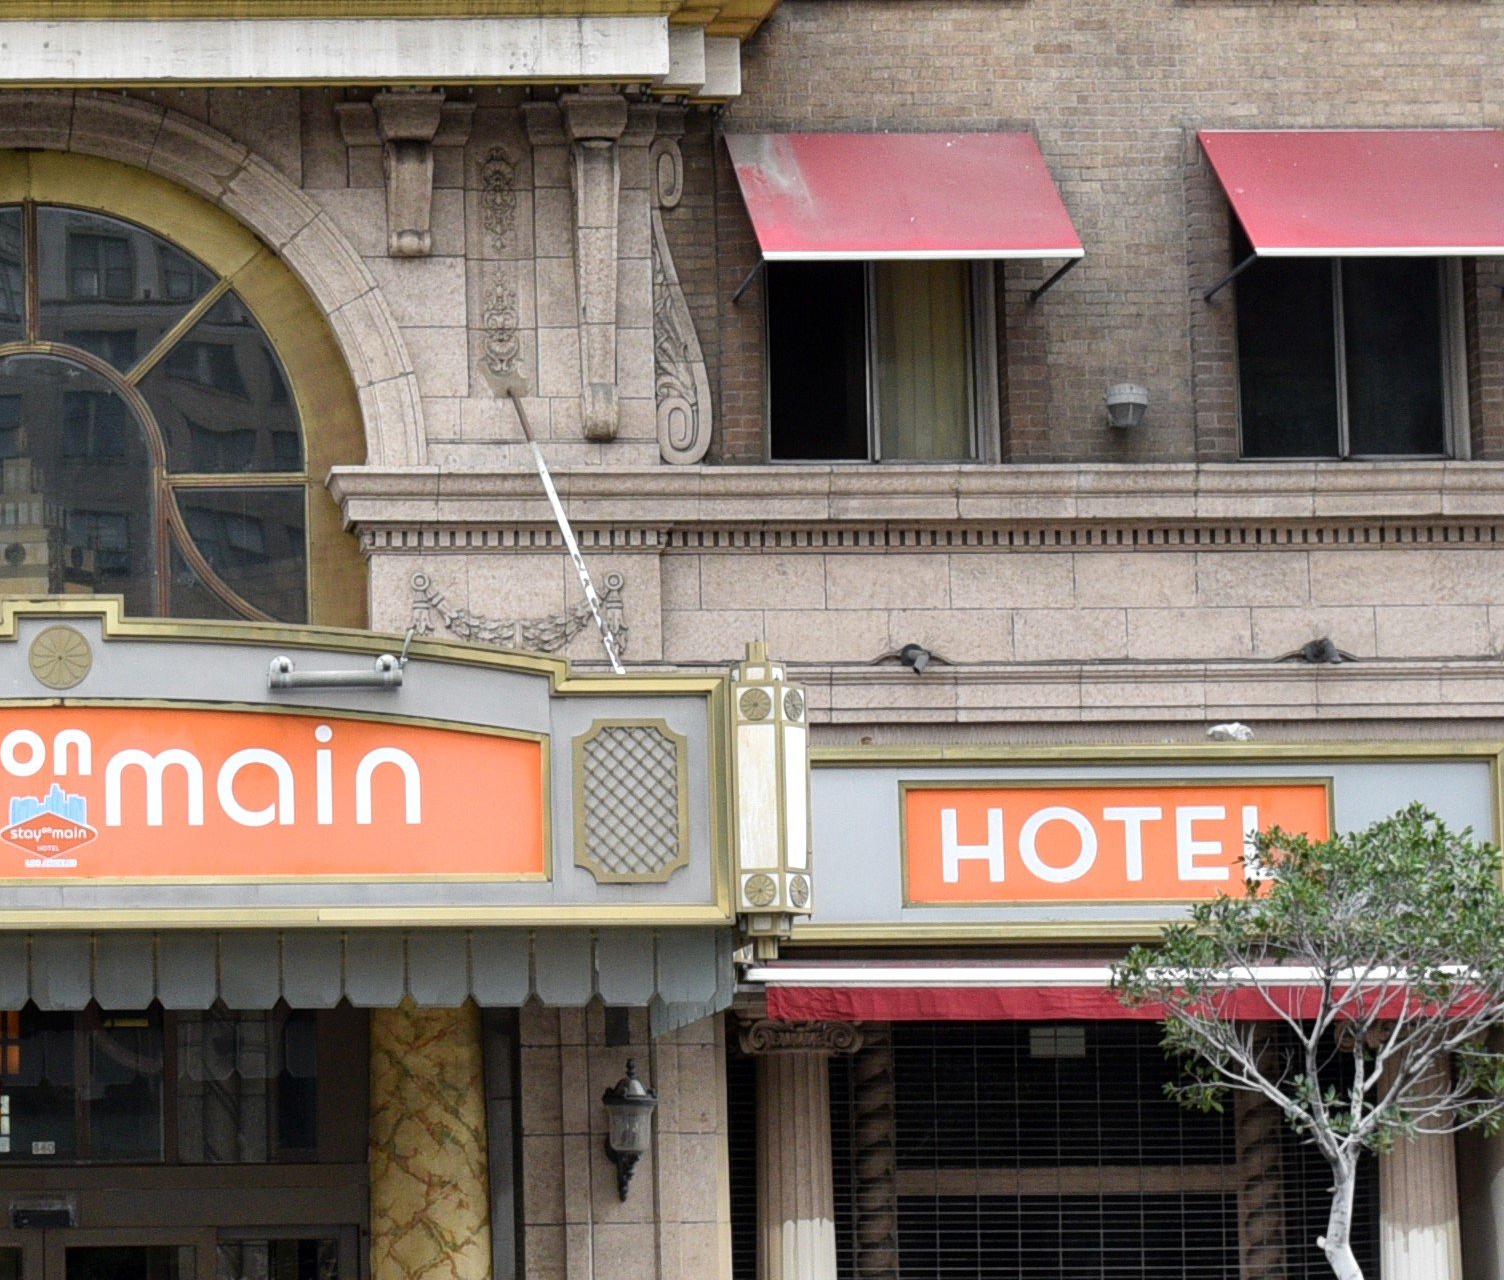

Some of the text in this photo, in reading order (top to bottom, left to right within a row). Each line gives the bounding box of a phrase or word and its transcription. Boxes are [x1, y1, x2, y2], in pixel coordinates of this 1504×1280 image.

[0, 729, 92, 777] on
[105, 726, 422, 827] main
[10, 828, 41, 842] stay
[52, 826, 87, 838] main
